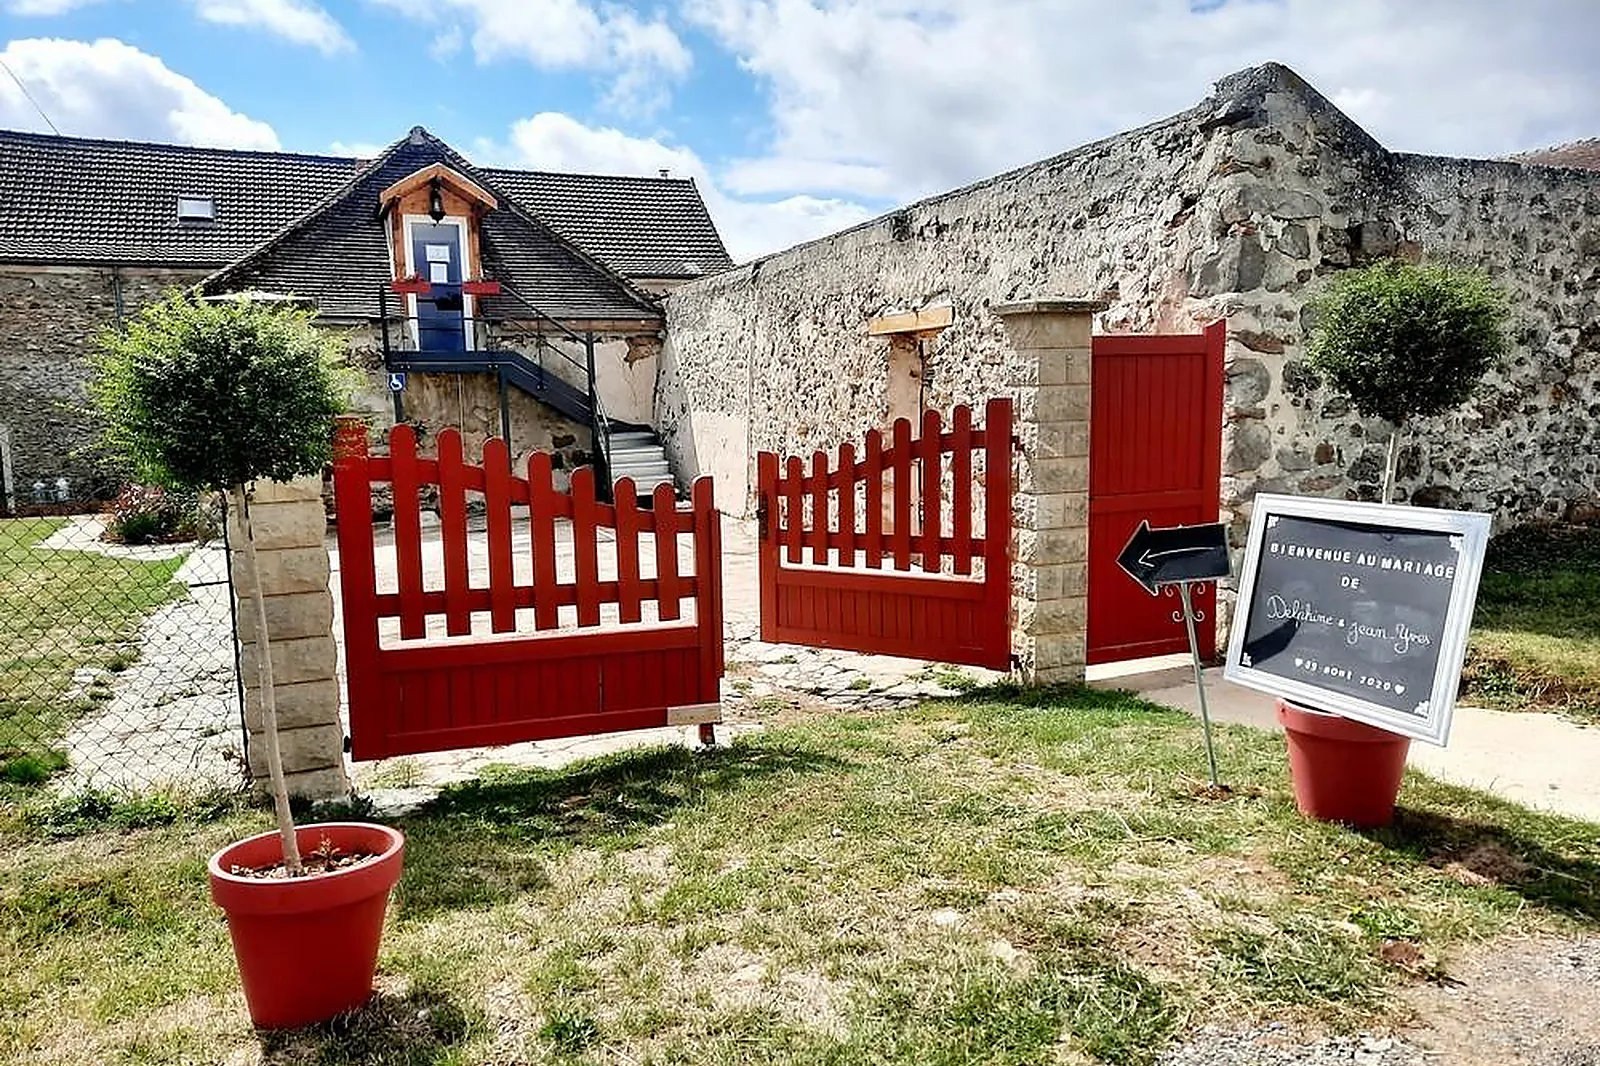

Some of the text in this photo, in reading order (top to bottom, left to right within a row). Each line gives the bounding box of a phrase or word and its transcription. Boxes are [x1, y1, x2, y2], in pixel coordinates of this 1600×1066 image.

[1270, 543, 1455, 579] BIENVENUE AU MARIAGE
[1341, 577, 1360, 589] DE
[1267, 595, 1333, 628] Delphine
[1360, 676, 1391, 690] 2020
